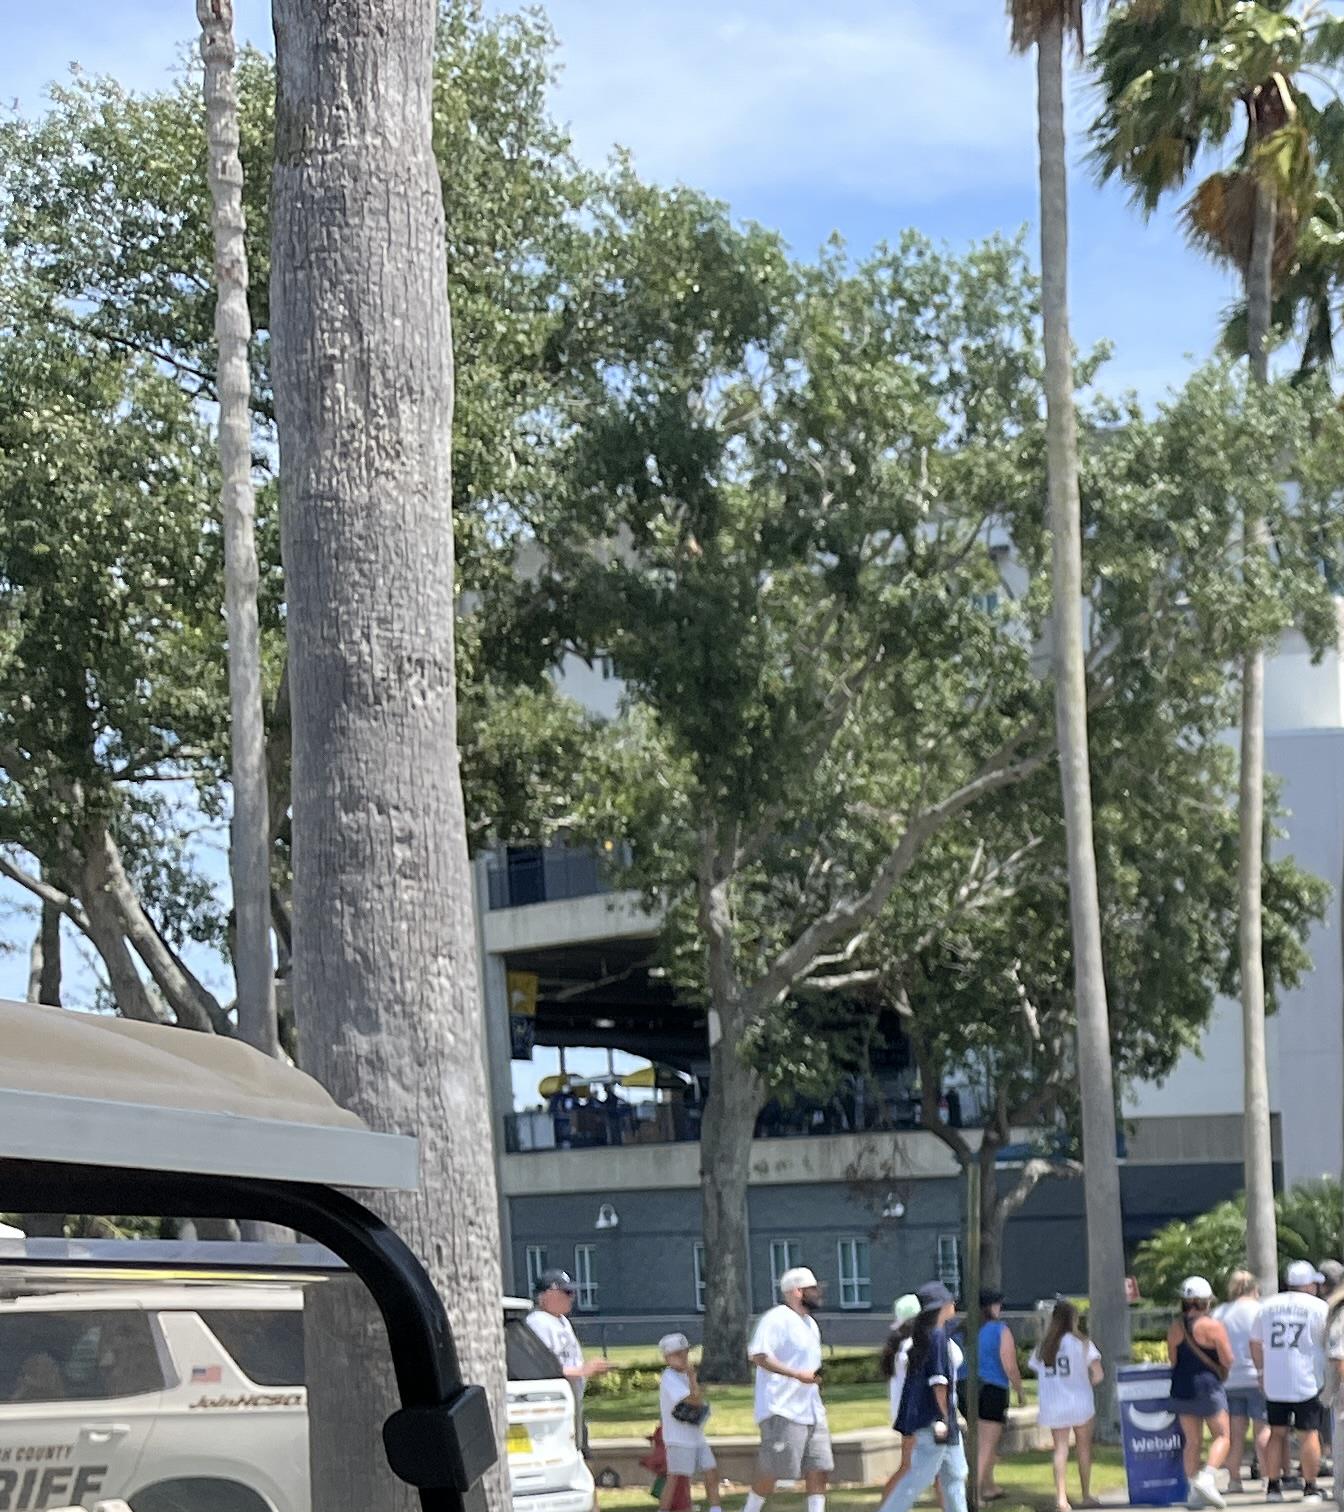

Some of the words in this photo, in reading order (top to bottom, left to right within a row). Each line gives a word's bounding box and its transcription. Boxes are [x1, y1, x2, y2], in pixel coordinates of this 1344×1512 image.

[1271, 1321, 1306, 1348] 27
[16, 1445, 73, 1461] COUNTY
[1131, 1434, 1181, 1453] Webull
